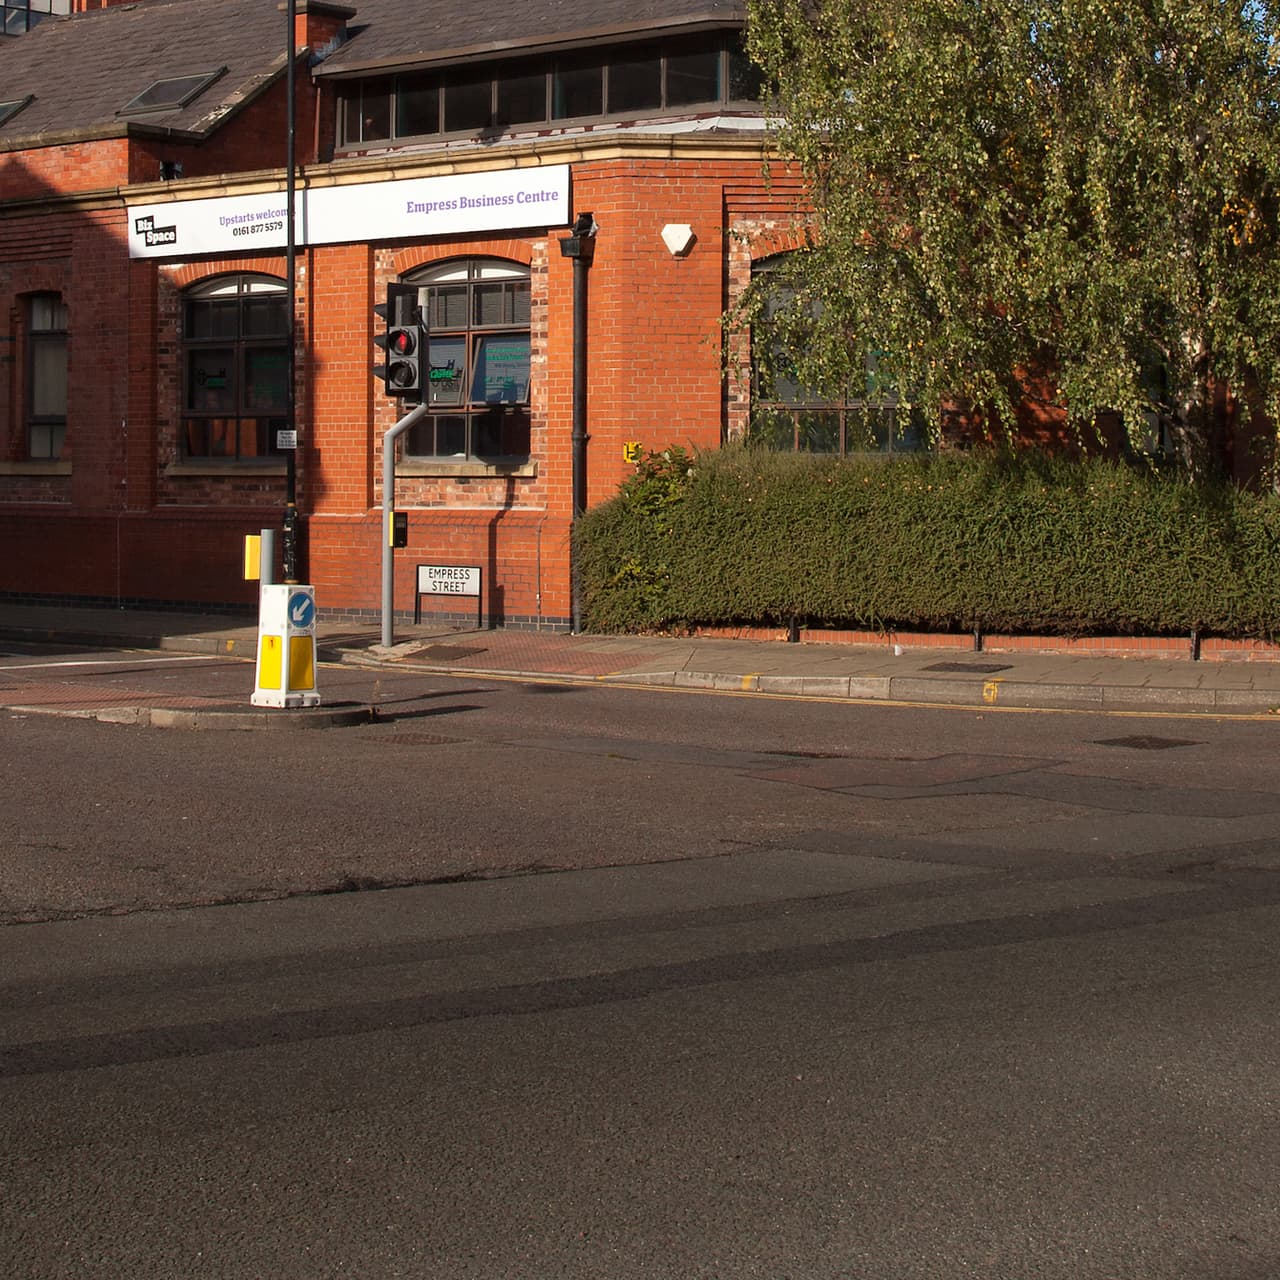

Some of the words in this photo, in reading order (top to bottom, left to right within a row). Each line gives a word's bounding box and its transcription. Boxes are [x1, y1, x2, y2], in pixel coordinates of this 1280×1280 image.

[406, 200, 458, 214] Empress
[459, 195, 514, 209] Business
[516, 190, 559, 204] Centre
[136, 218, 154, 231] Biz
[219, 212, 255, 226] Upstarts
[256, 208, 296, 221] welcom
[232, 225, 250, 237] 0161
[250, 223, 264, 234] 877
[265, 221, 284, 232] 5579
[146, 230, 176, 245] Space
[428, 568, 471, 580] EMPRESS
[432, 581, 466, 593] STREET
